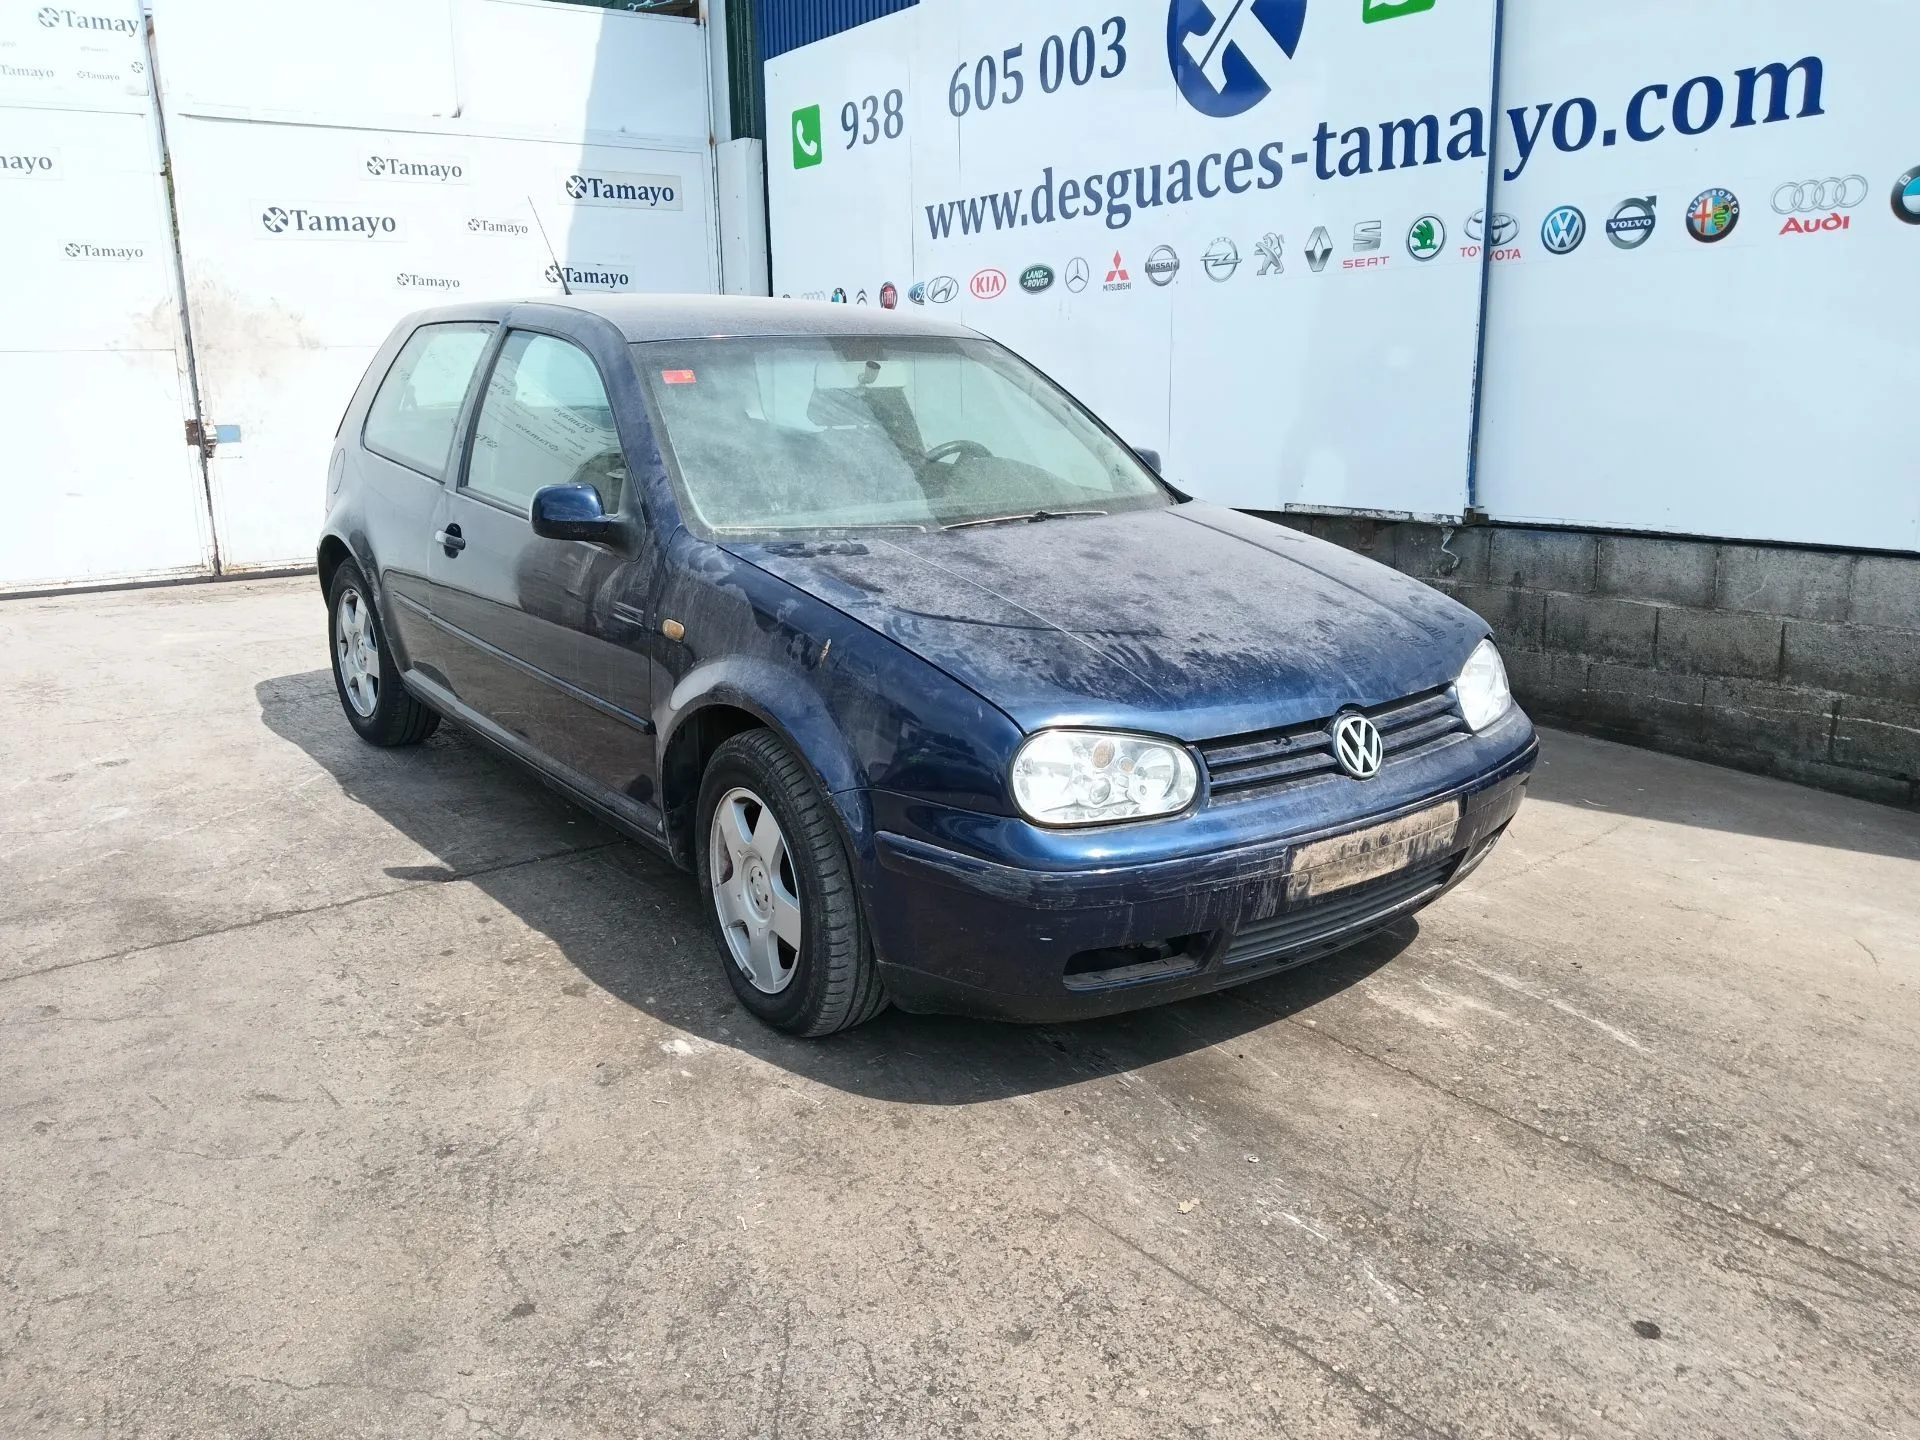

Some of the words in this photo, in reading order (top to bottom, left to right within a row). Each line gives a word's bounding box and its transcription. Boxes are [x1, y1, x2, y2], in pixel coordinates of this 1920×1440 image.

[60, 9, 140, 38] Tamay
[840, 87, 904, 150] 938
[947, 42, 1024, 118] 605
[1039, 16, 1127, 94] 003
[925, 54, 1826, 240] www.desguaces-tamayo.com
[386, 158, 463, 181] Tamayo
[588, 178, 675, 206] Tamayo
[1711, 189, 1739, 215] ROMEO
[290, 209, 396, 238] Tamayo
[480, 220, 529, 235] Tamayo
[1610, 218, 1652, 229] VOLVO
[81, 244, 144, 261] Tamayo
[1148, 261, 1177, 270] NISSAN
[1342, 255, 1390, 269] SEAT
[409, 274, 461, 291] Tamayo
[562, 267, 629, 288] Tamayo
[1026, 270, 1044, 279] LAND
[1027, 278, 1049, 287] ROVER
[976, 277, 1001, 293] KIA
[1102, 282, 1132, 292] MITSUBISHI
